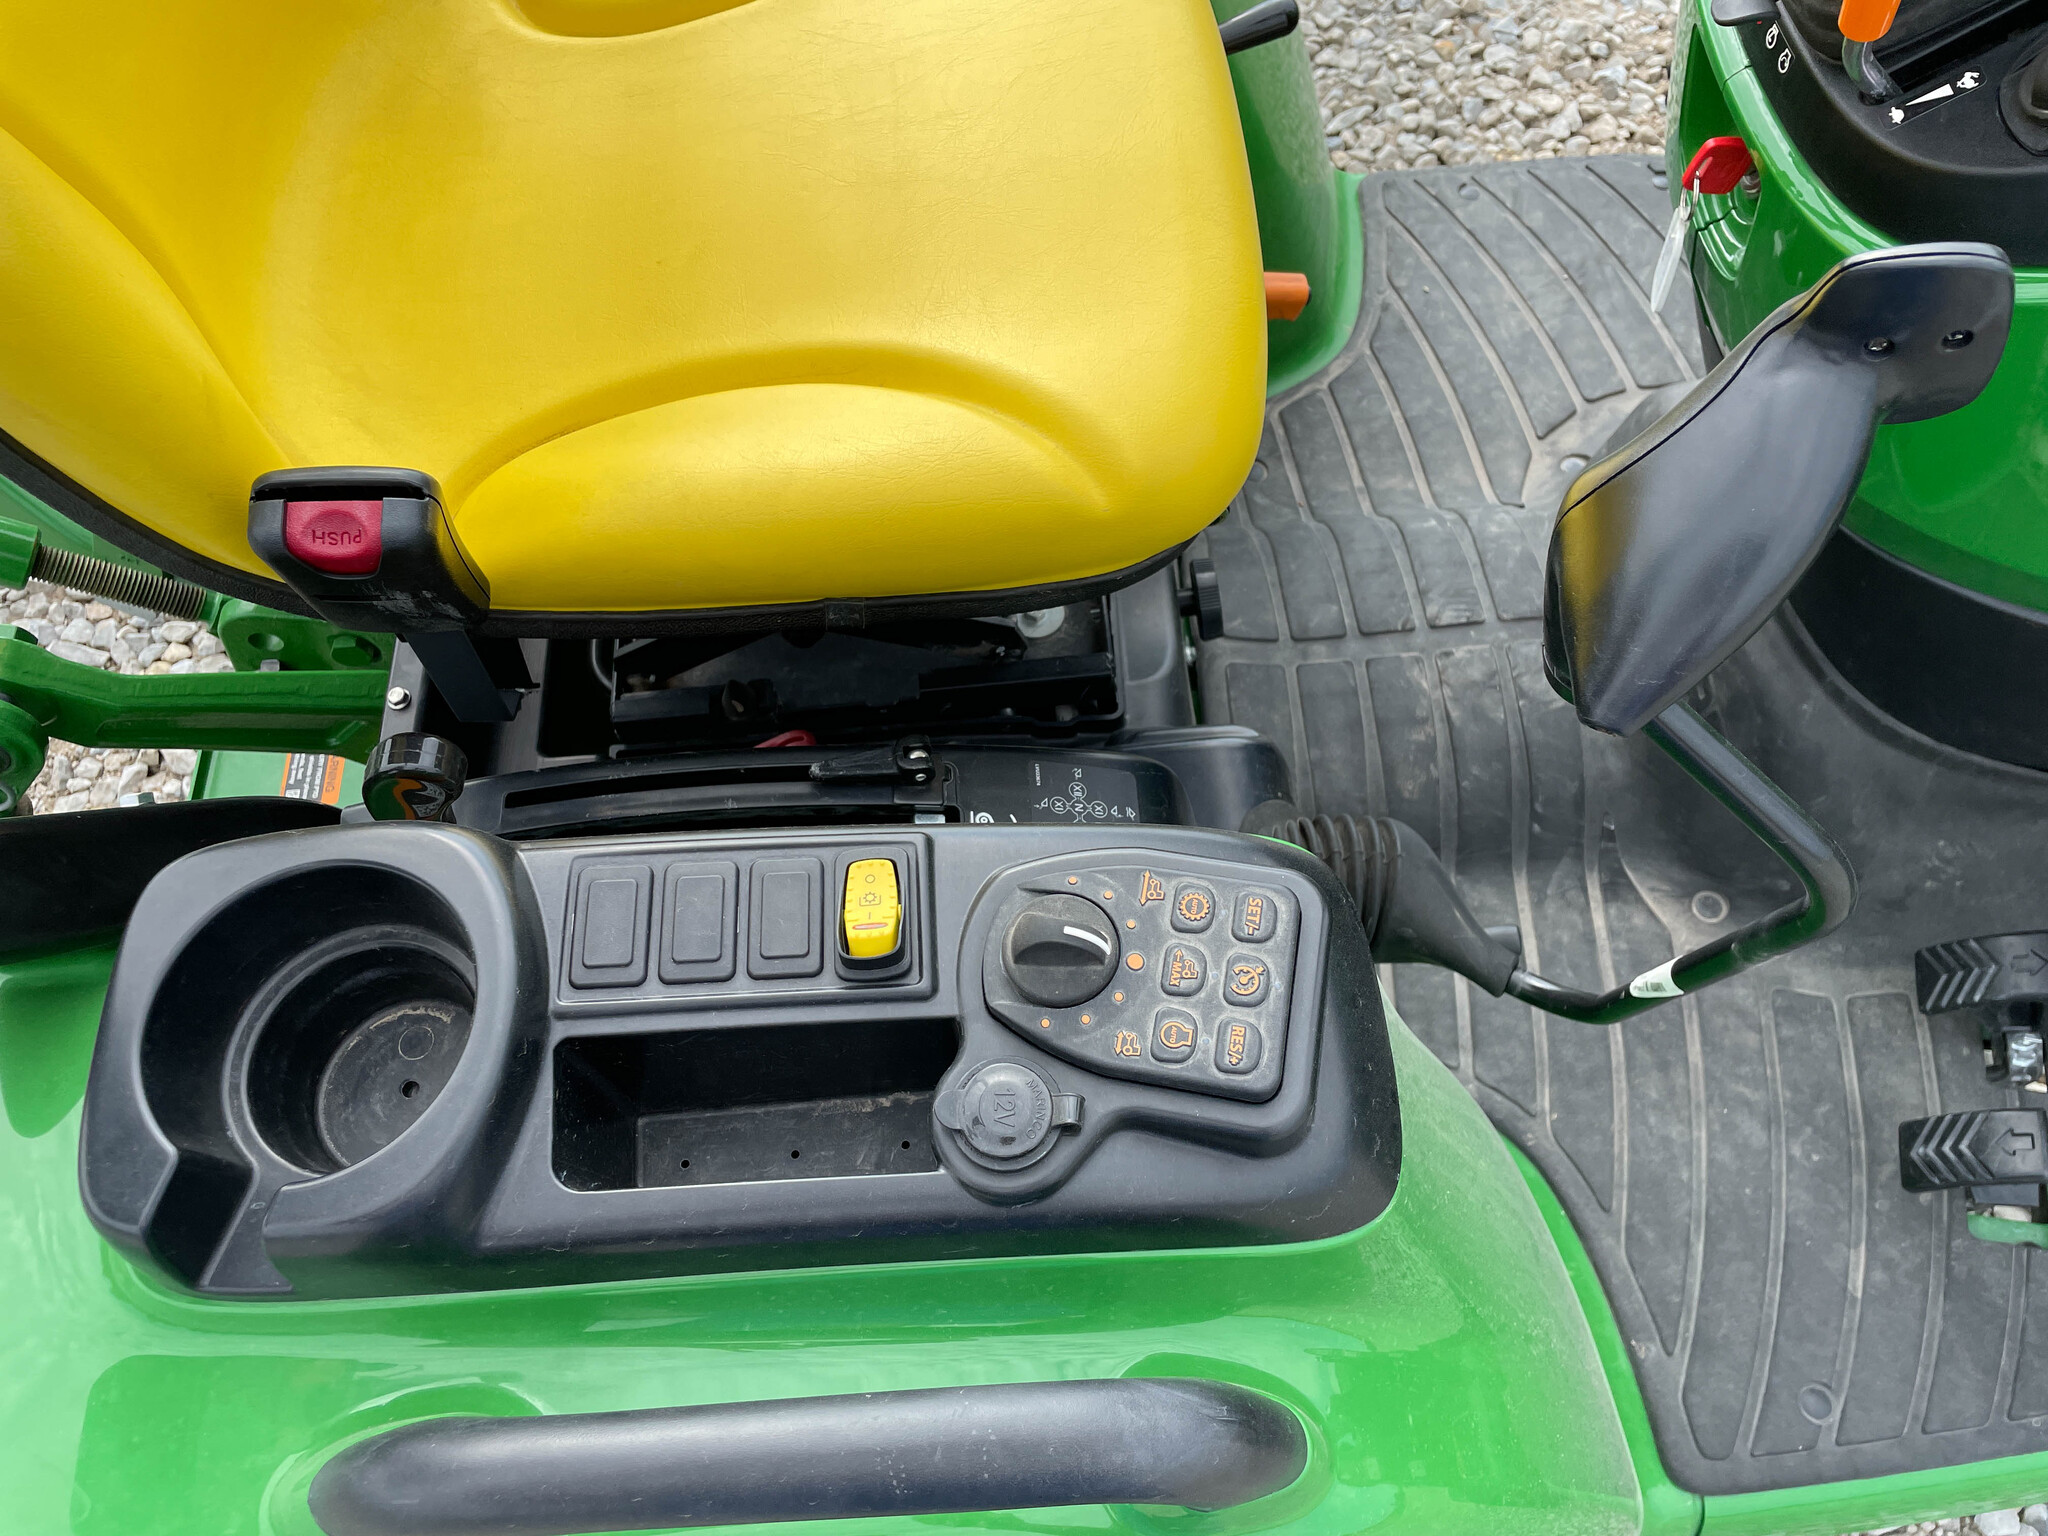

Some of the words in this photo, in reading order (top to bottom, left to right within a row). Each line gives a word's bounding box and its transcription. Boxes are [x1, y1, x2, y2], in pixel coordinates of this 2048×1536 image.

[311, 528, 362, 546] PUSH
[1190, 898, 1199, 915] AUTO
[1169, 961, 1183, 987] MAX
[1169, 1026, 1177, 1043] AUTO
[993, 1089, 1017, 1128] 12V
[1025, 1078, 1046, 1140] MARINCO
